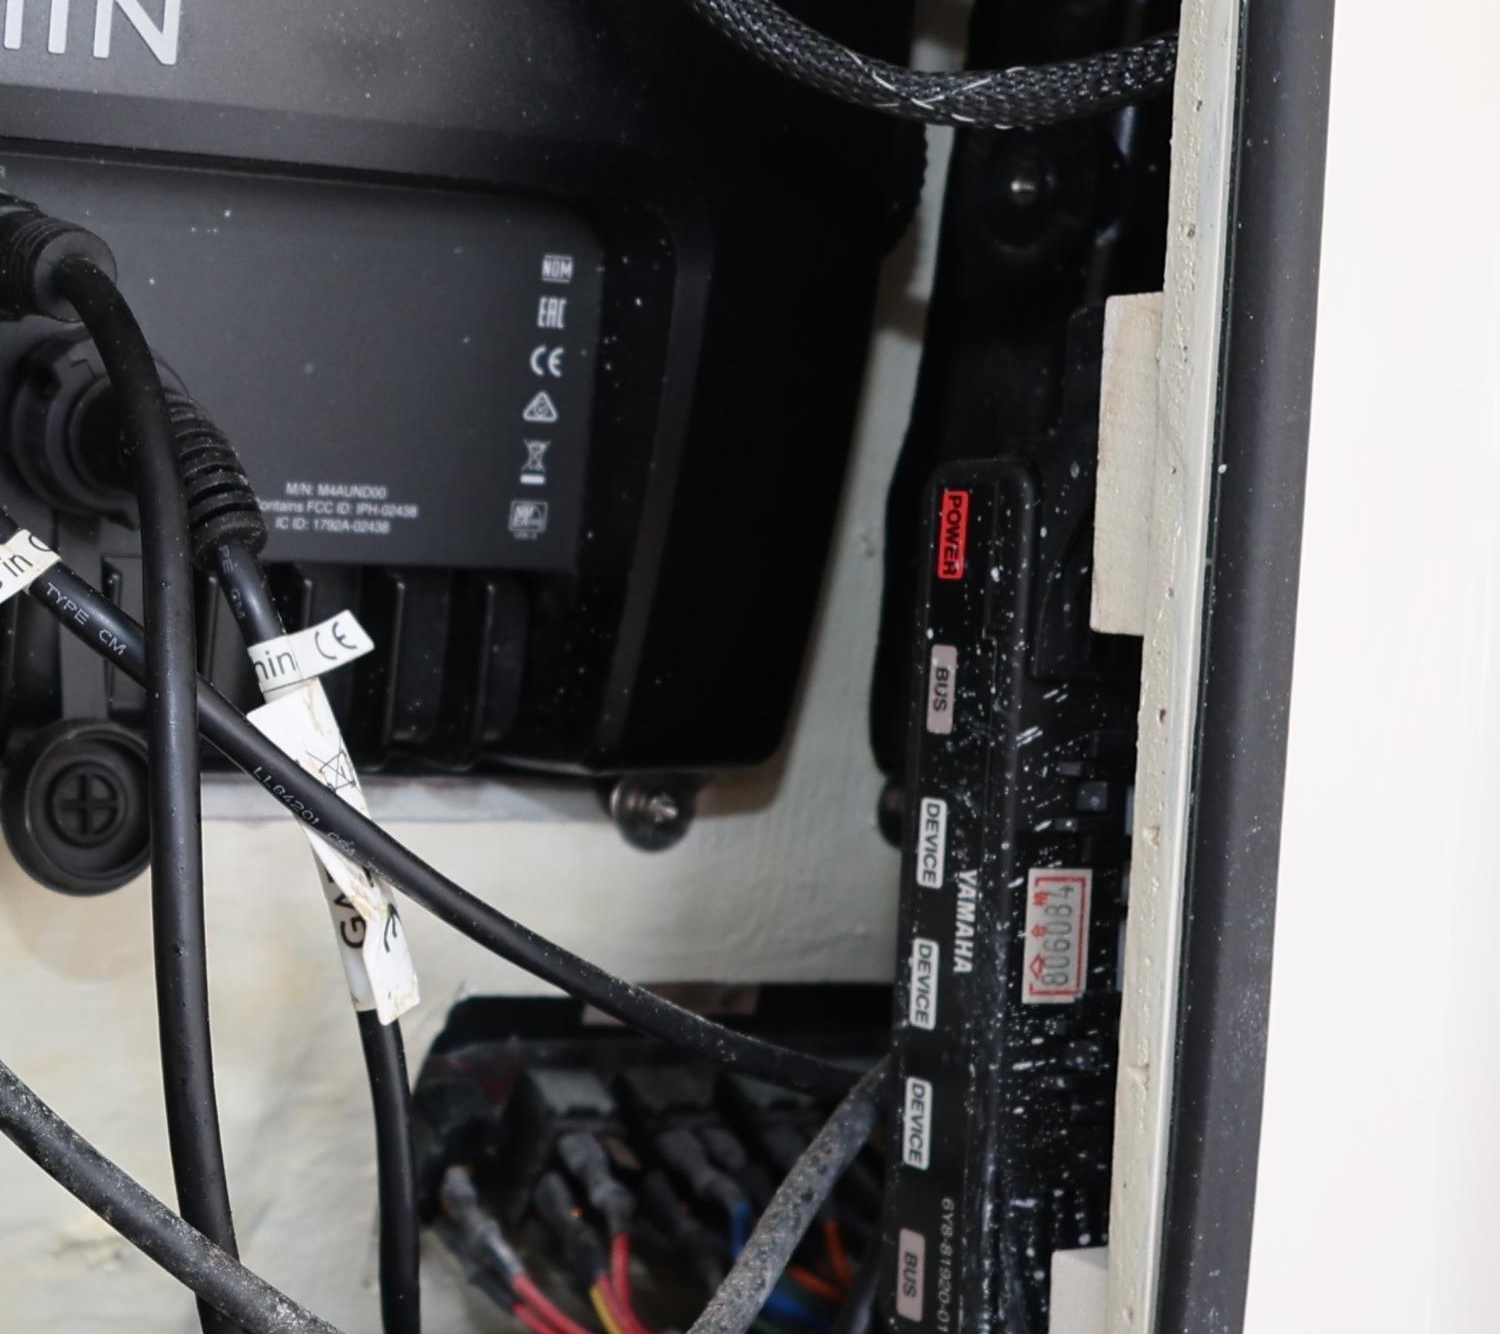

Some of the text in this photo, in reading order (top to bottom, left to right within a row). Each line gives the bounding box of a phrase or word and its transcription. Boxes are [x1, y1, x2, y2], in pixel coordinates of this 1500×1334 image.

[536, 296, 567, 329] EAC
[529, 344, 564, 377] CE
[275, 517, 289, 530] IC
[306, 501, 335, 515] FCC
[336, 502, 352, 515] ID:
[942, 494, 963, 576] POWER
[45, 582, 128, 656] TYPE CM
[932, 668, 949, 712] BUS
[922, 802, 941, 885] DEVICE
[953, 869, 978, 974] YAMAHA
[915, 943, 933, 1025] DEVICE
[908, 1083, 925, 1164] DEVICE
[902, 1251, 918, 1299] BUS
[936, 1197, 955, 1333] 6Y8-81920-01
